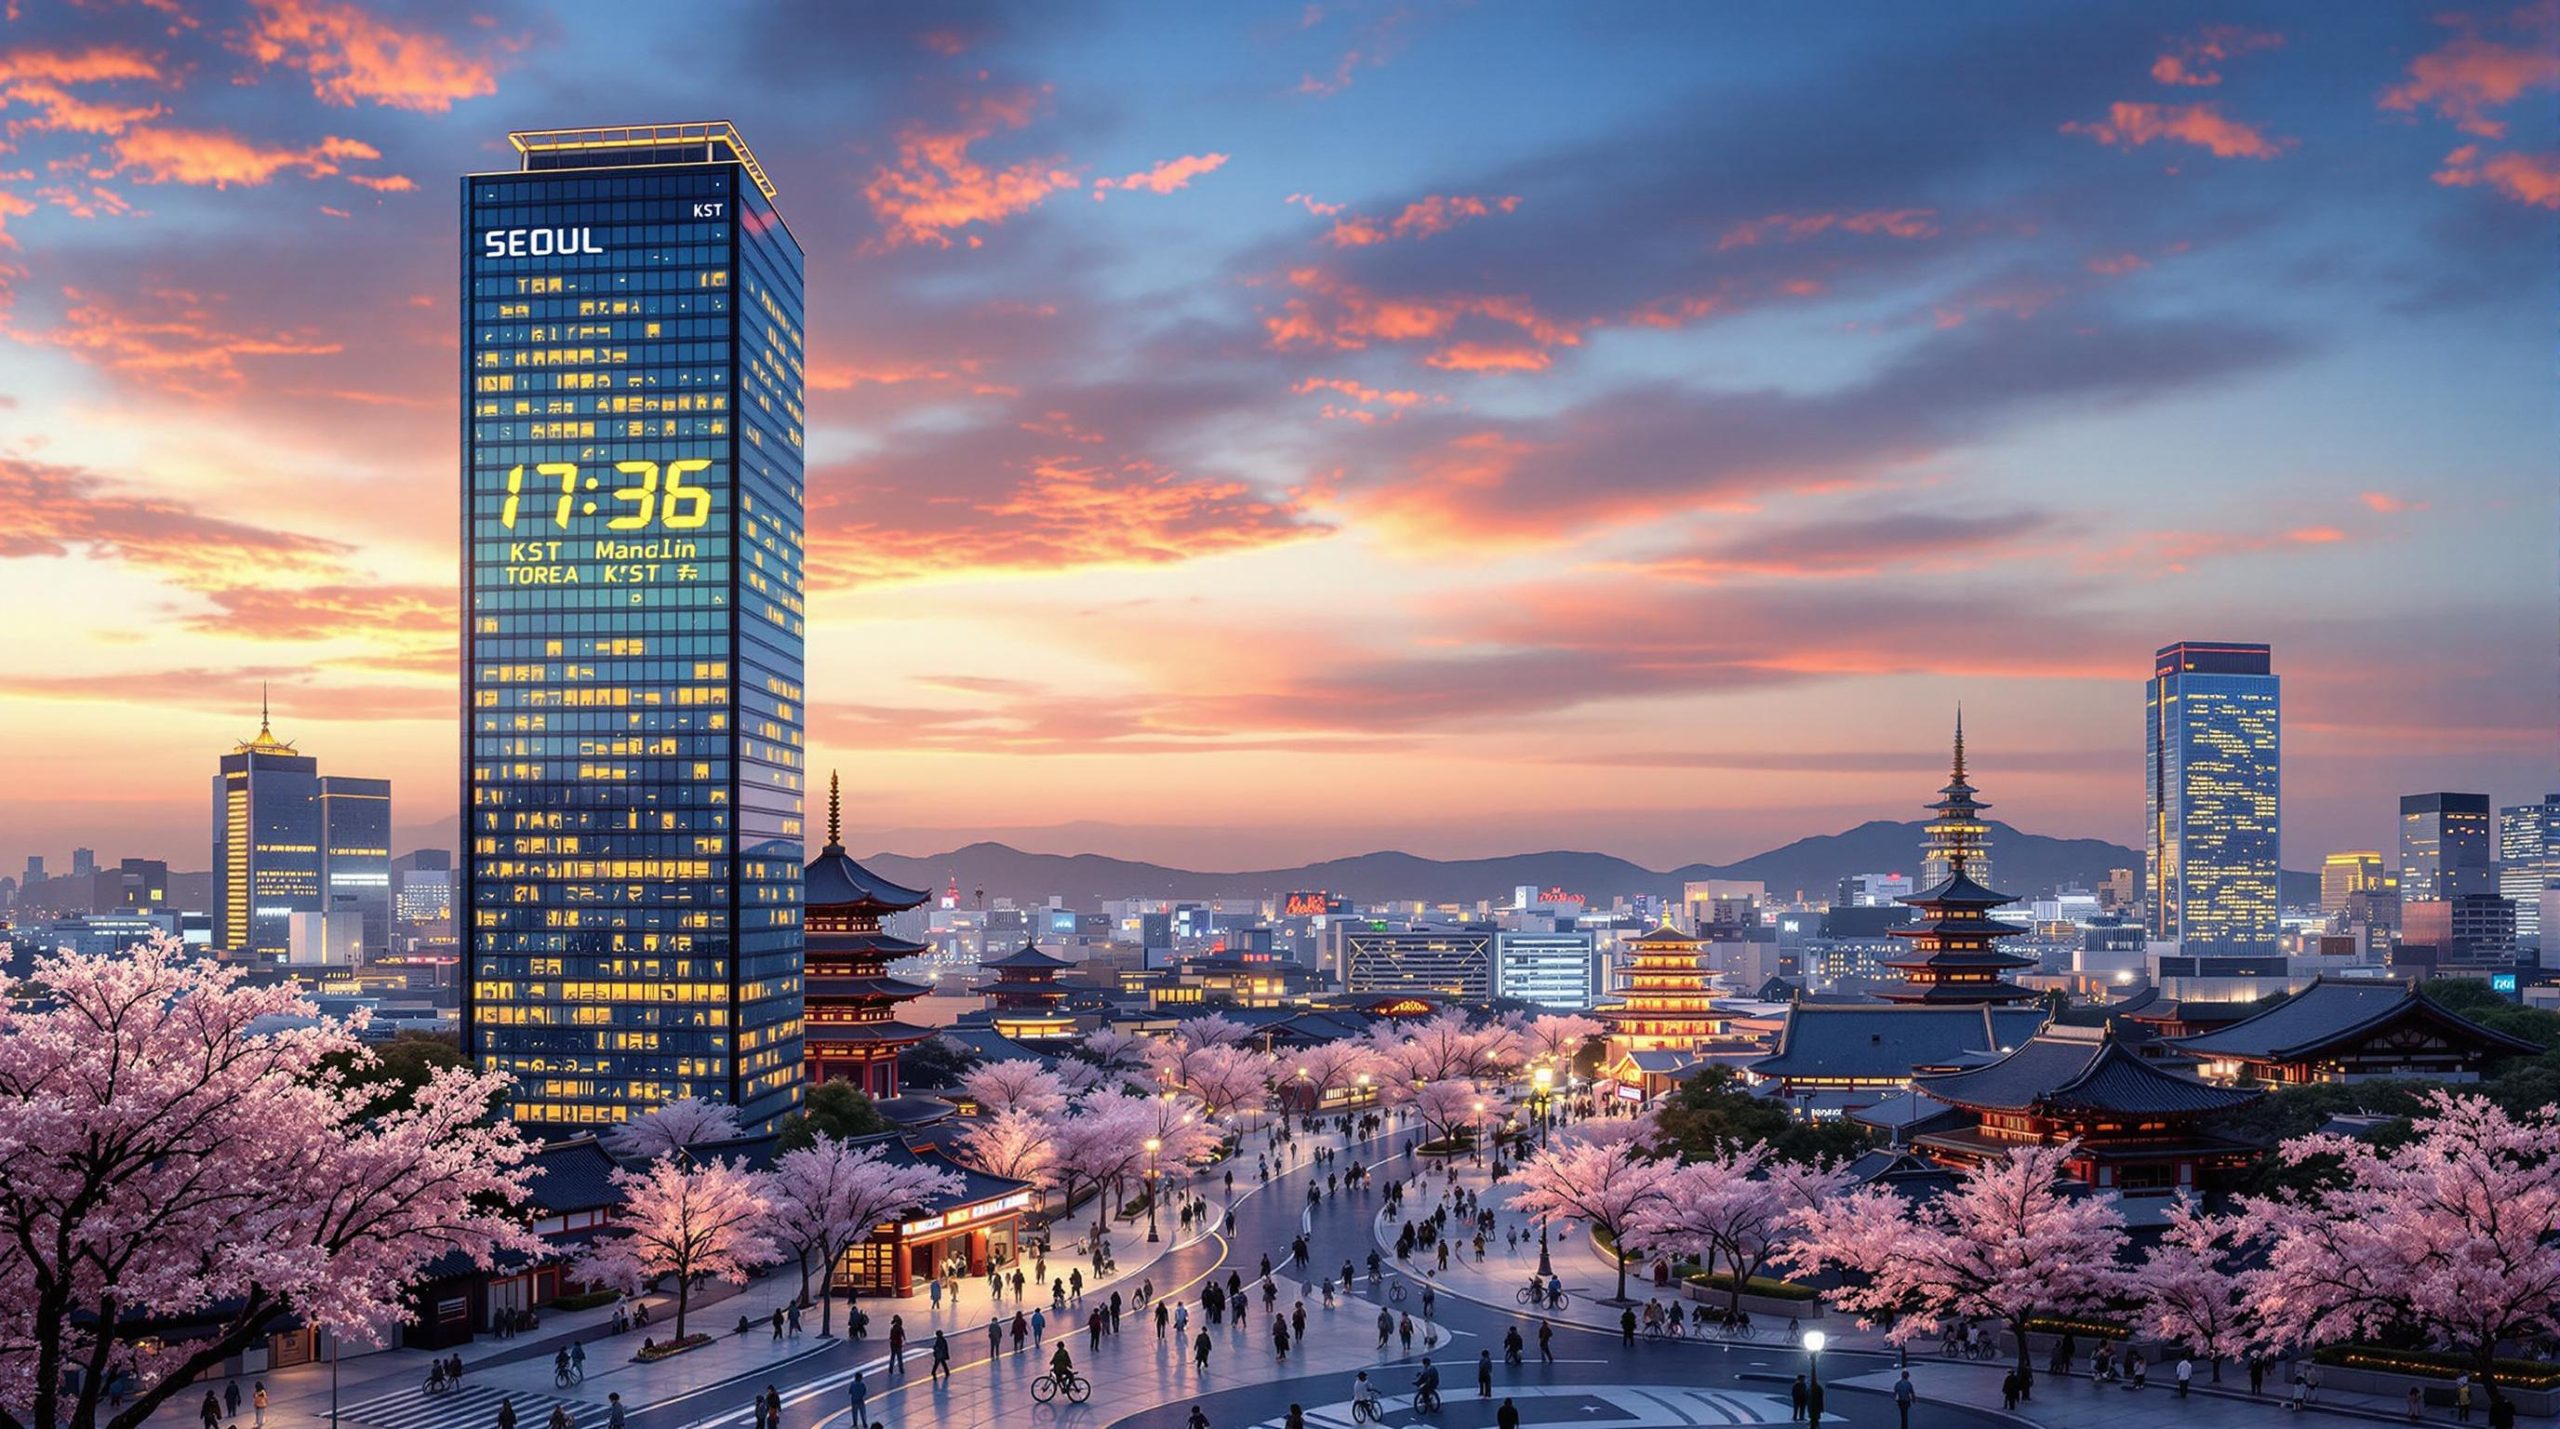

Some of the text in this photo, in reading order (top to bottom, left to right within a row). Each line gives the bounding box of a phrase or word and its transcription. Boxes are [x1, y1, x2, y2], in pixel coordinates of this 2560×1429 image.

[693, 203, 723, 218] KST
[485, 227, 603, 257] SEOUL
[501, 459, 713, 530] 17:36
[510, 541, 562, 562] KST
[505, 565, 579, 584] TOREA
